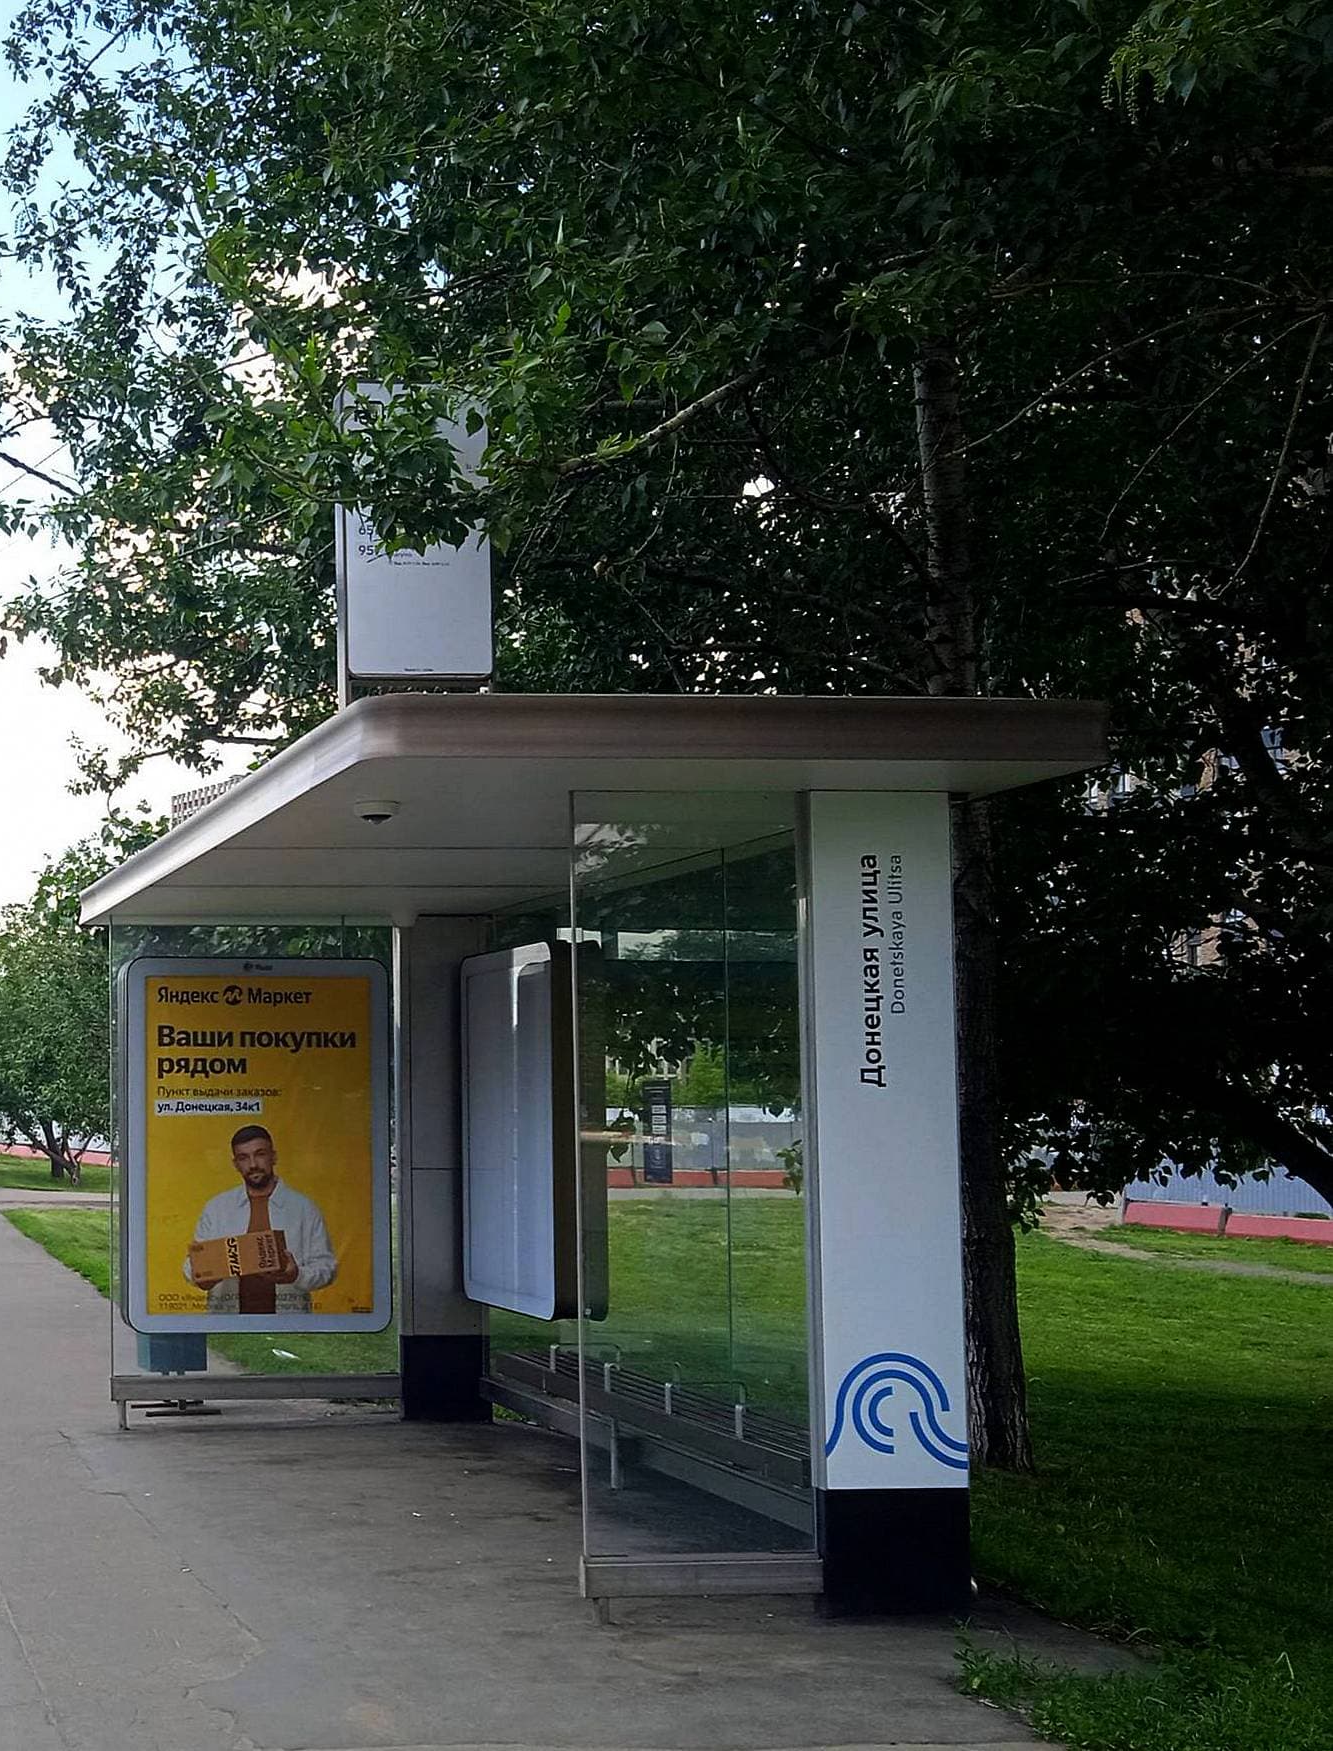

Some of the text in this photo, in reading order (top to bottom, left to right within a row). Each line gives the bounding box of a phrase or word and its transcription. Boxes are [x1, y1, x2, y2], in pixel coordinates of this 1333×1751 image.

[887, 854, 906, 1014] Donetskaya Ulitsa
[859, 853, 887, 1088] Донецкая улица
[157, 986, 313, 1007] Яндекс Маркет
[157, 1024, 357, 1053] Ваши покупки
[157, 1057, 248, 1079] рядом
[157, 1086, 190, 1098] Пункт
[192, 1087, 234, 1098] выдачи
[157, 1102, 173, 1113] ул.
